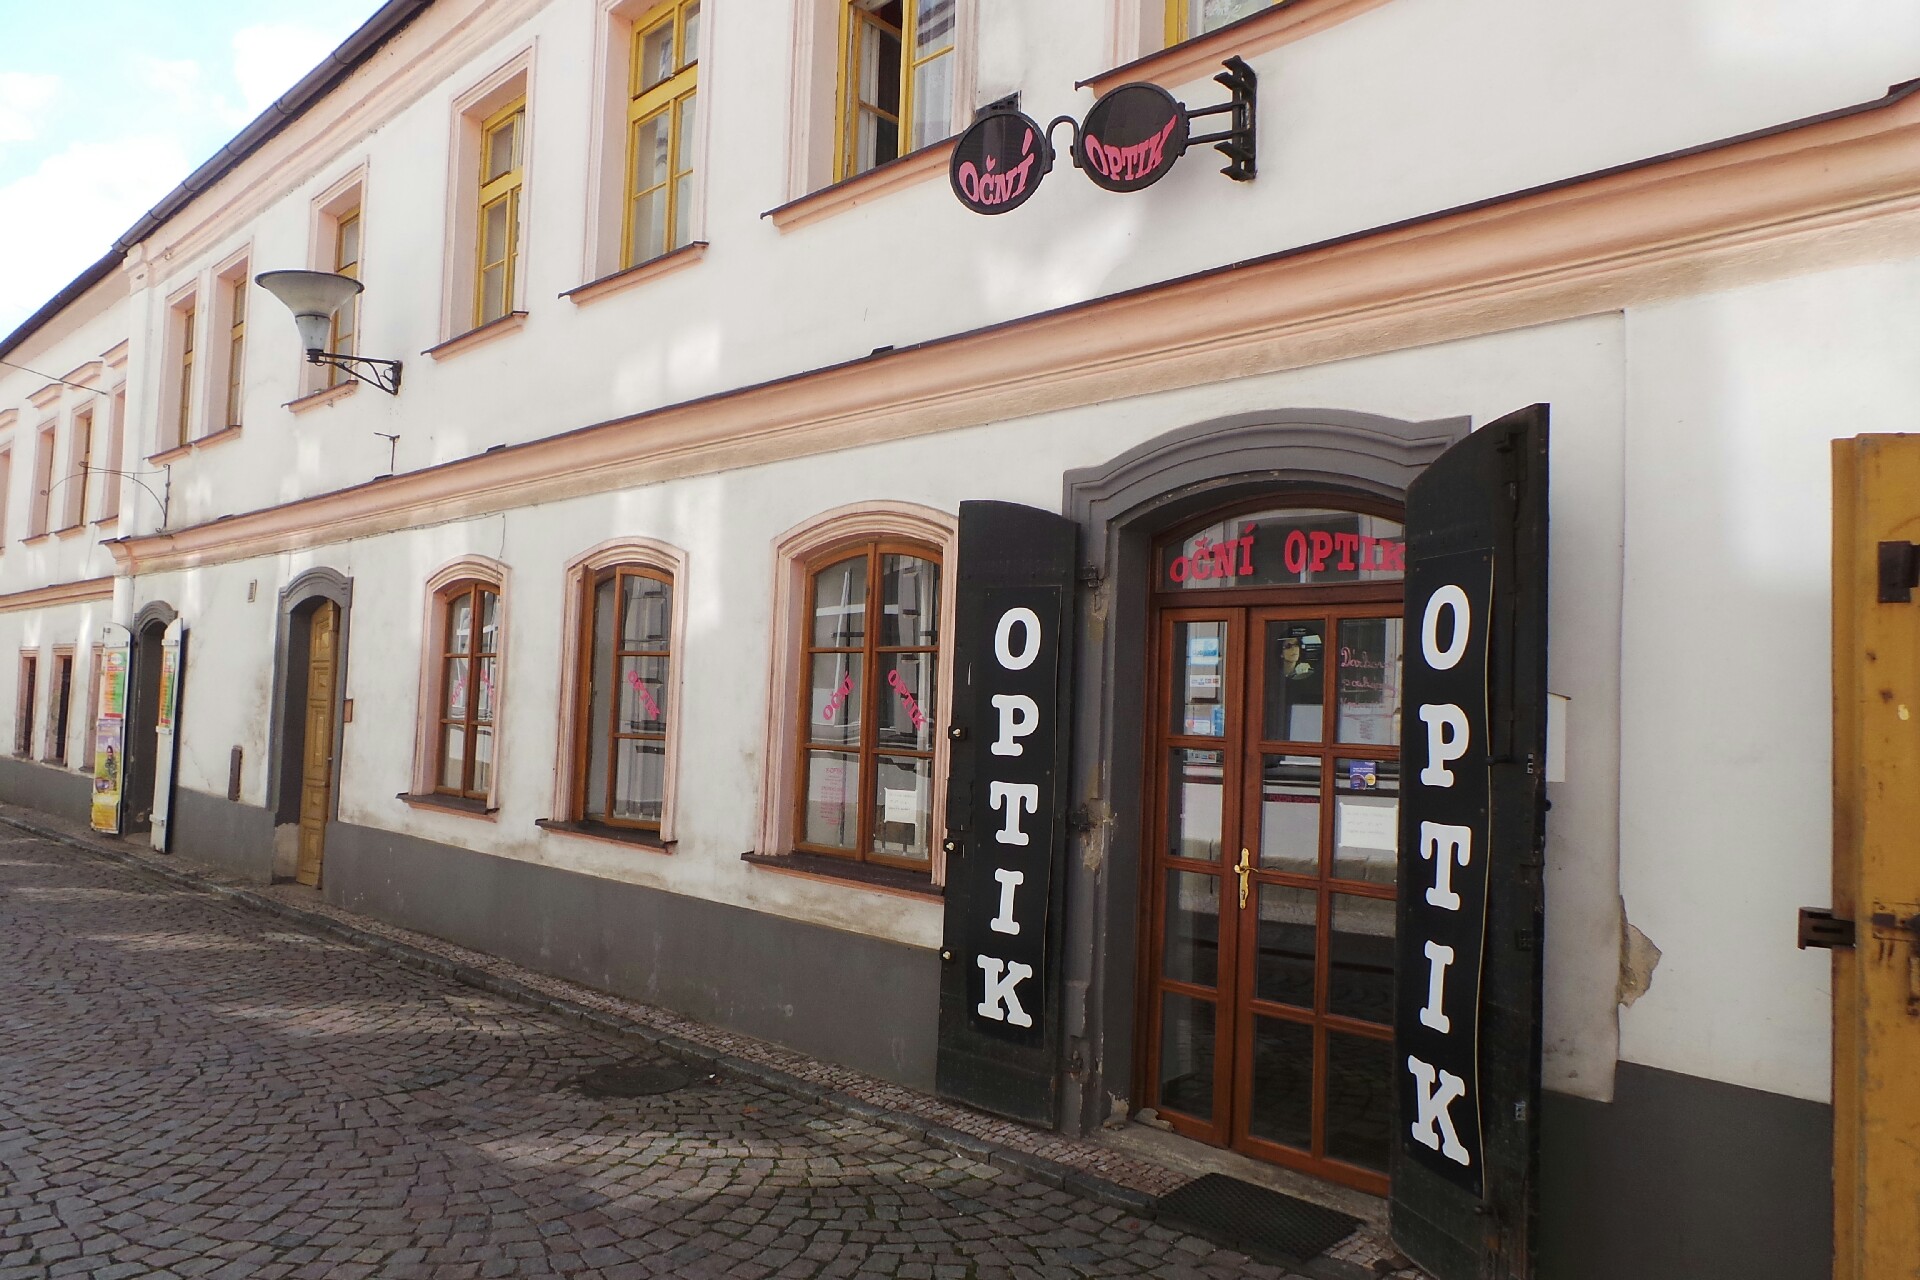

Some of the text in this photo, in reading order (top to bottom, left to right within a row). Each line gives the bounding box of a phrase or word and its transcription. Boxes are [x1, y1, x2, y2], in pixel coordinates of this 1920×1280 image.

[959, 114, 1177, 205] OČNÍ OPTIK
[1170, 524, 1405, 582] OČNÍ OPTIK
[888, 669, 927, 730] OPTIK
[976, 607, 1042, 1028] OPTIK
[1407, 584, 1473, 1166] OPTIK
